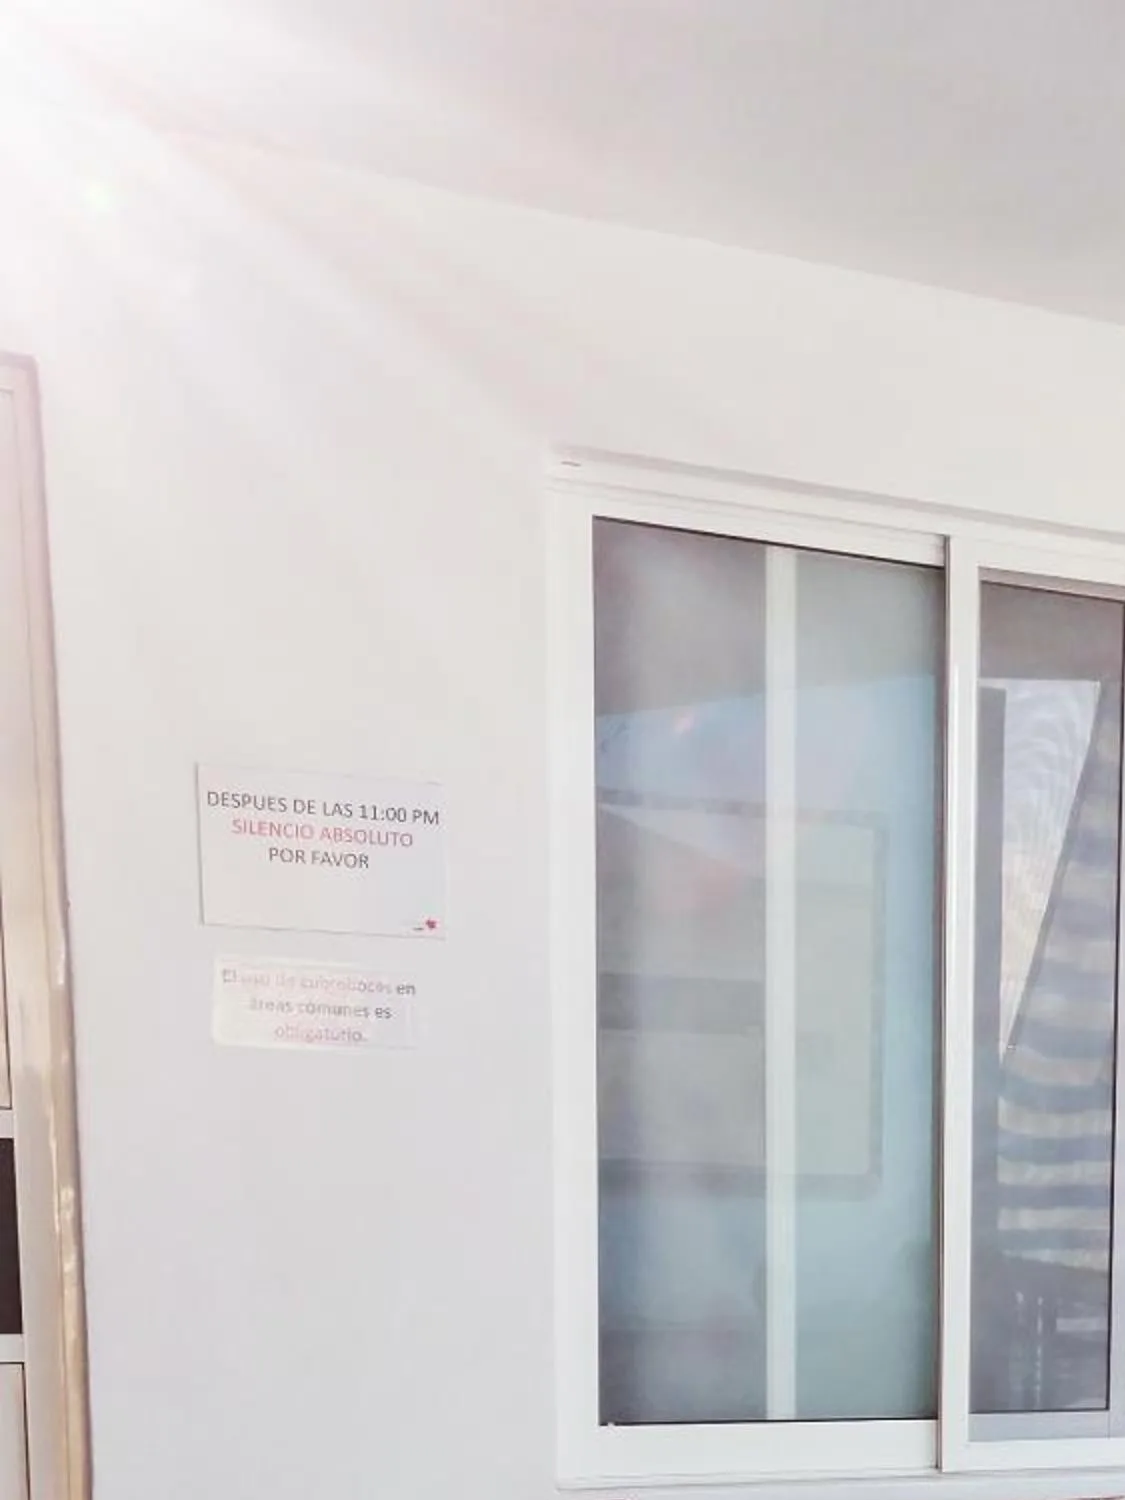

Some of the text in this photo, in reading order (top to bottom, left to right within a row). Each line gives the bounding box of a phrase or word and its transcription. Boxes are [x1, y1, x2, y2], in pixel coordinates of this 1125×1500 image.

[207, 791, 440, 826] DESPUES DE LAS 11:00 PM
[231, 819, 414, 848] SILENCIO ABSOLUTO
[268, 847, 369, 869] POR FAVOR
[396, 983, 416, 996] en
[374, 1007, 393, 1019] es
